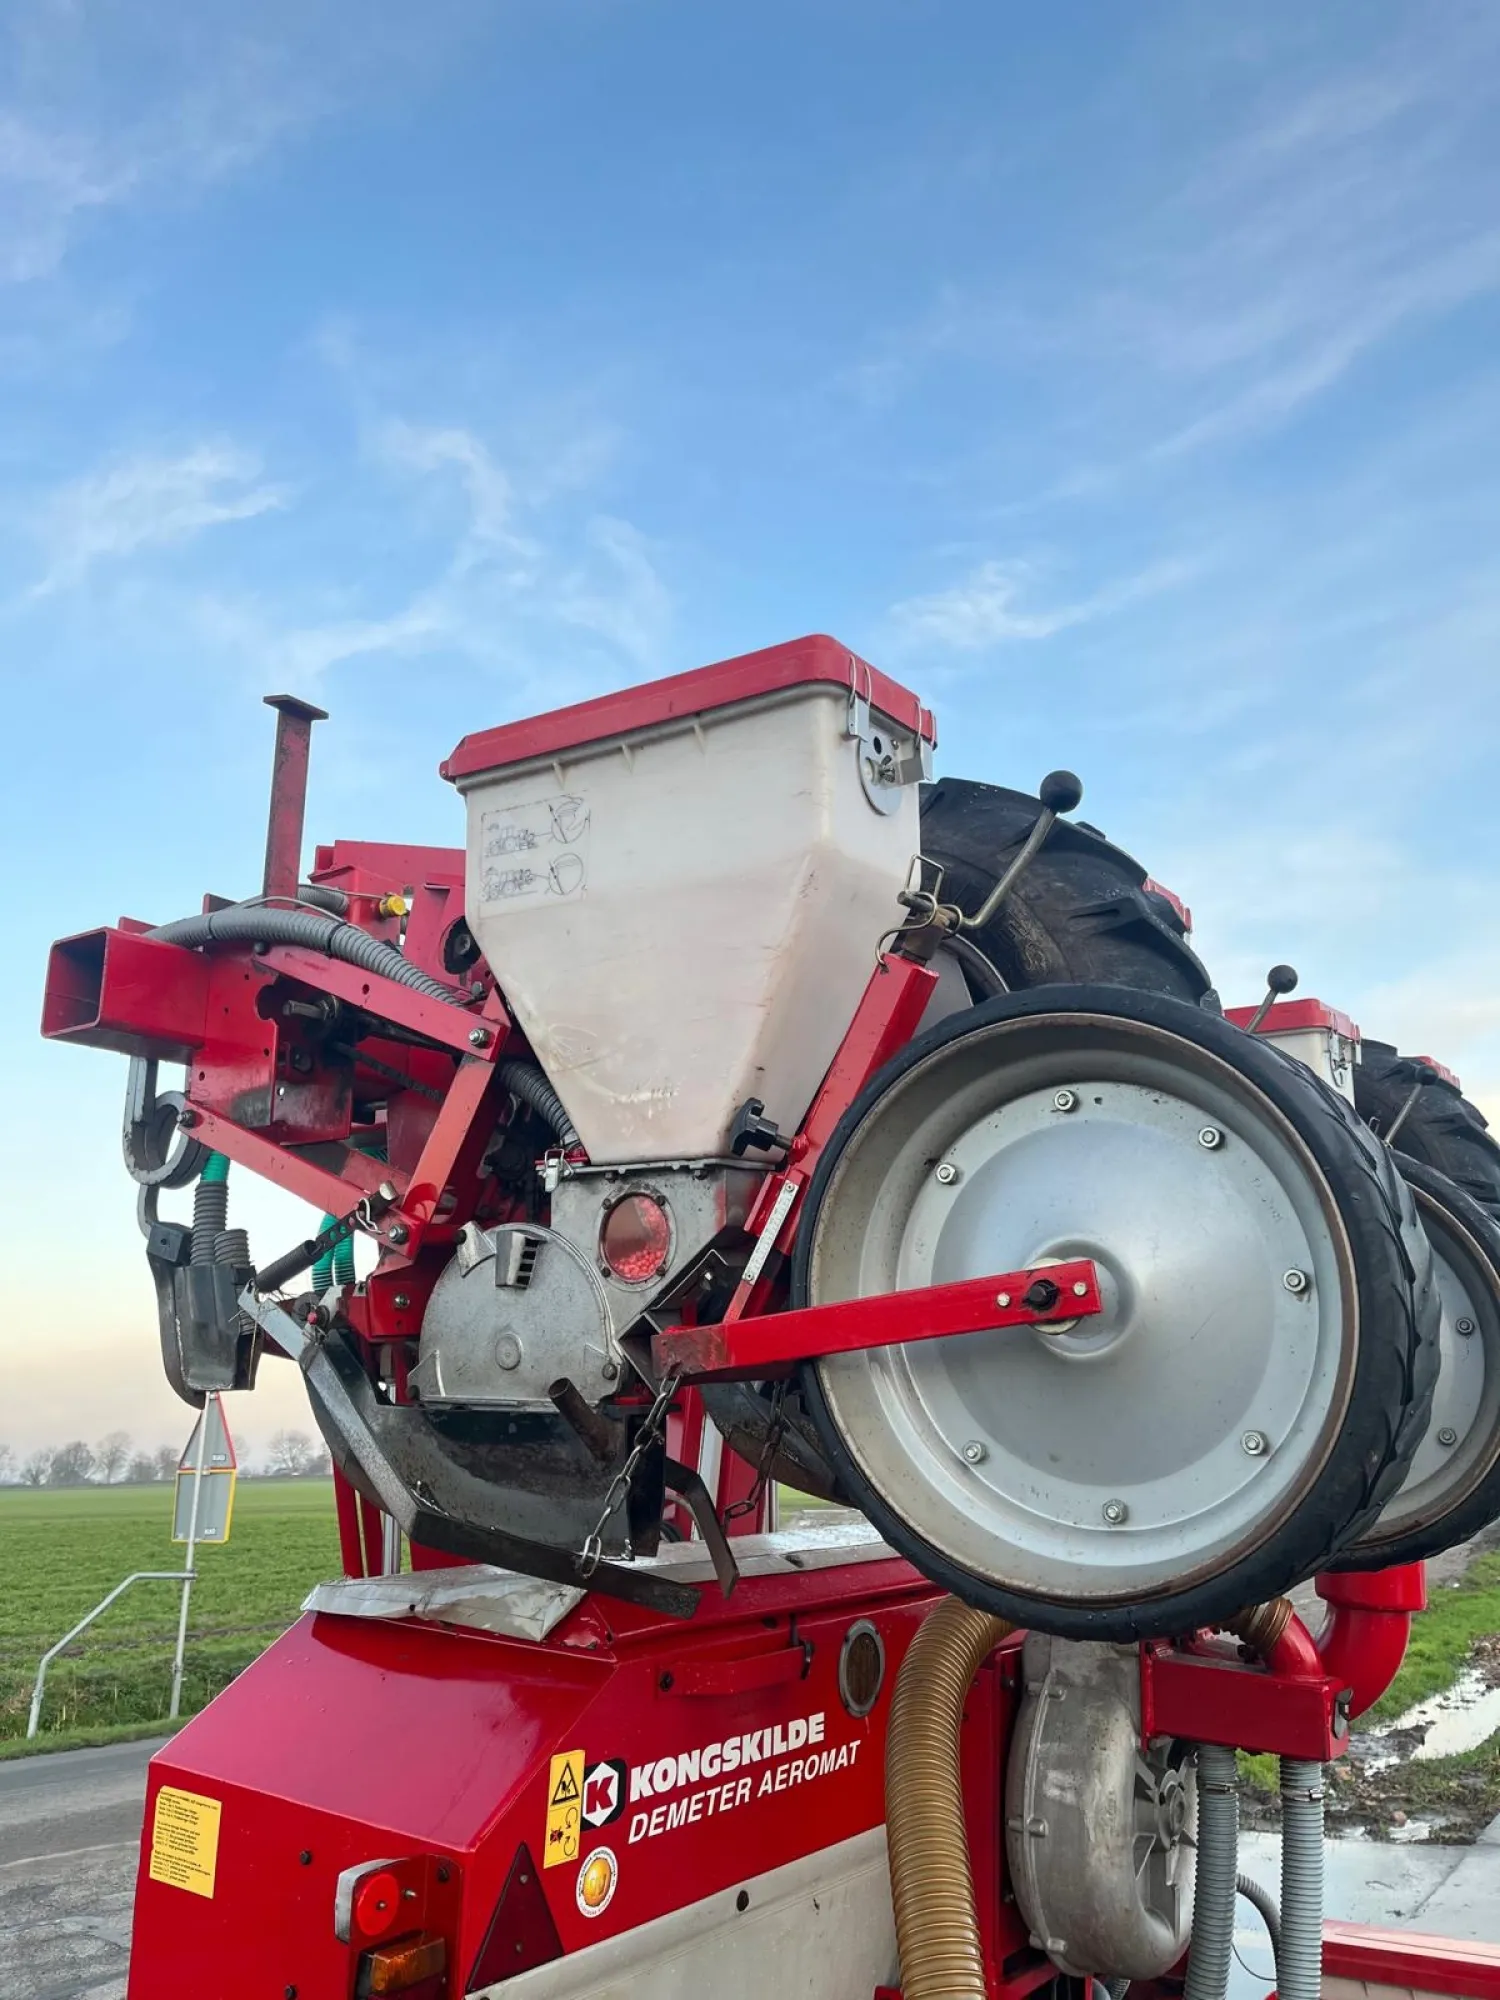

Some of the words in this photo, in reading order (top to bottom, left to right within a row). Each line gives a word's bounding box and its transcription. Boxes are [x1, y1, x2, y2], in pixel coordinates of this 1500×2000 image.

[586, 1775, 614, 1814] K
[628, 1776, 751, 1844] DEMETER
[757, 1740, 861, 1797] AEROMAT
[629, 1712, 825, 1802] KONGSKILDE
